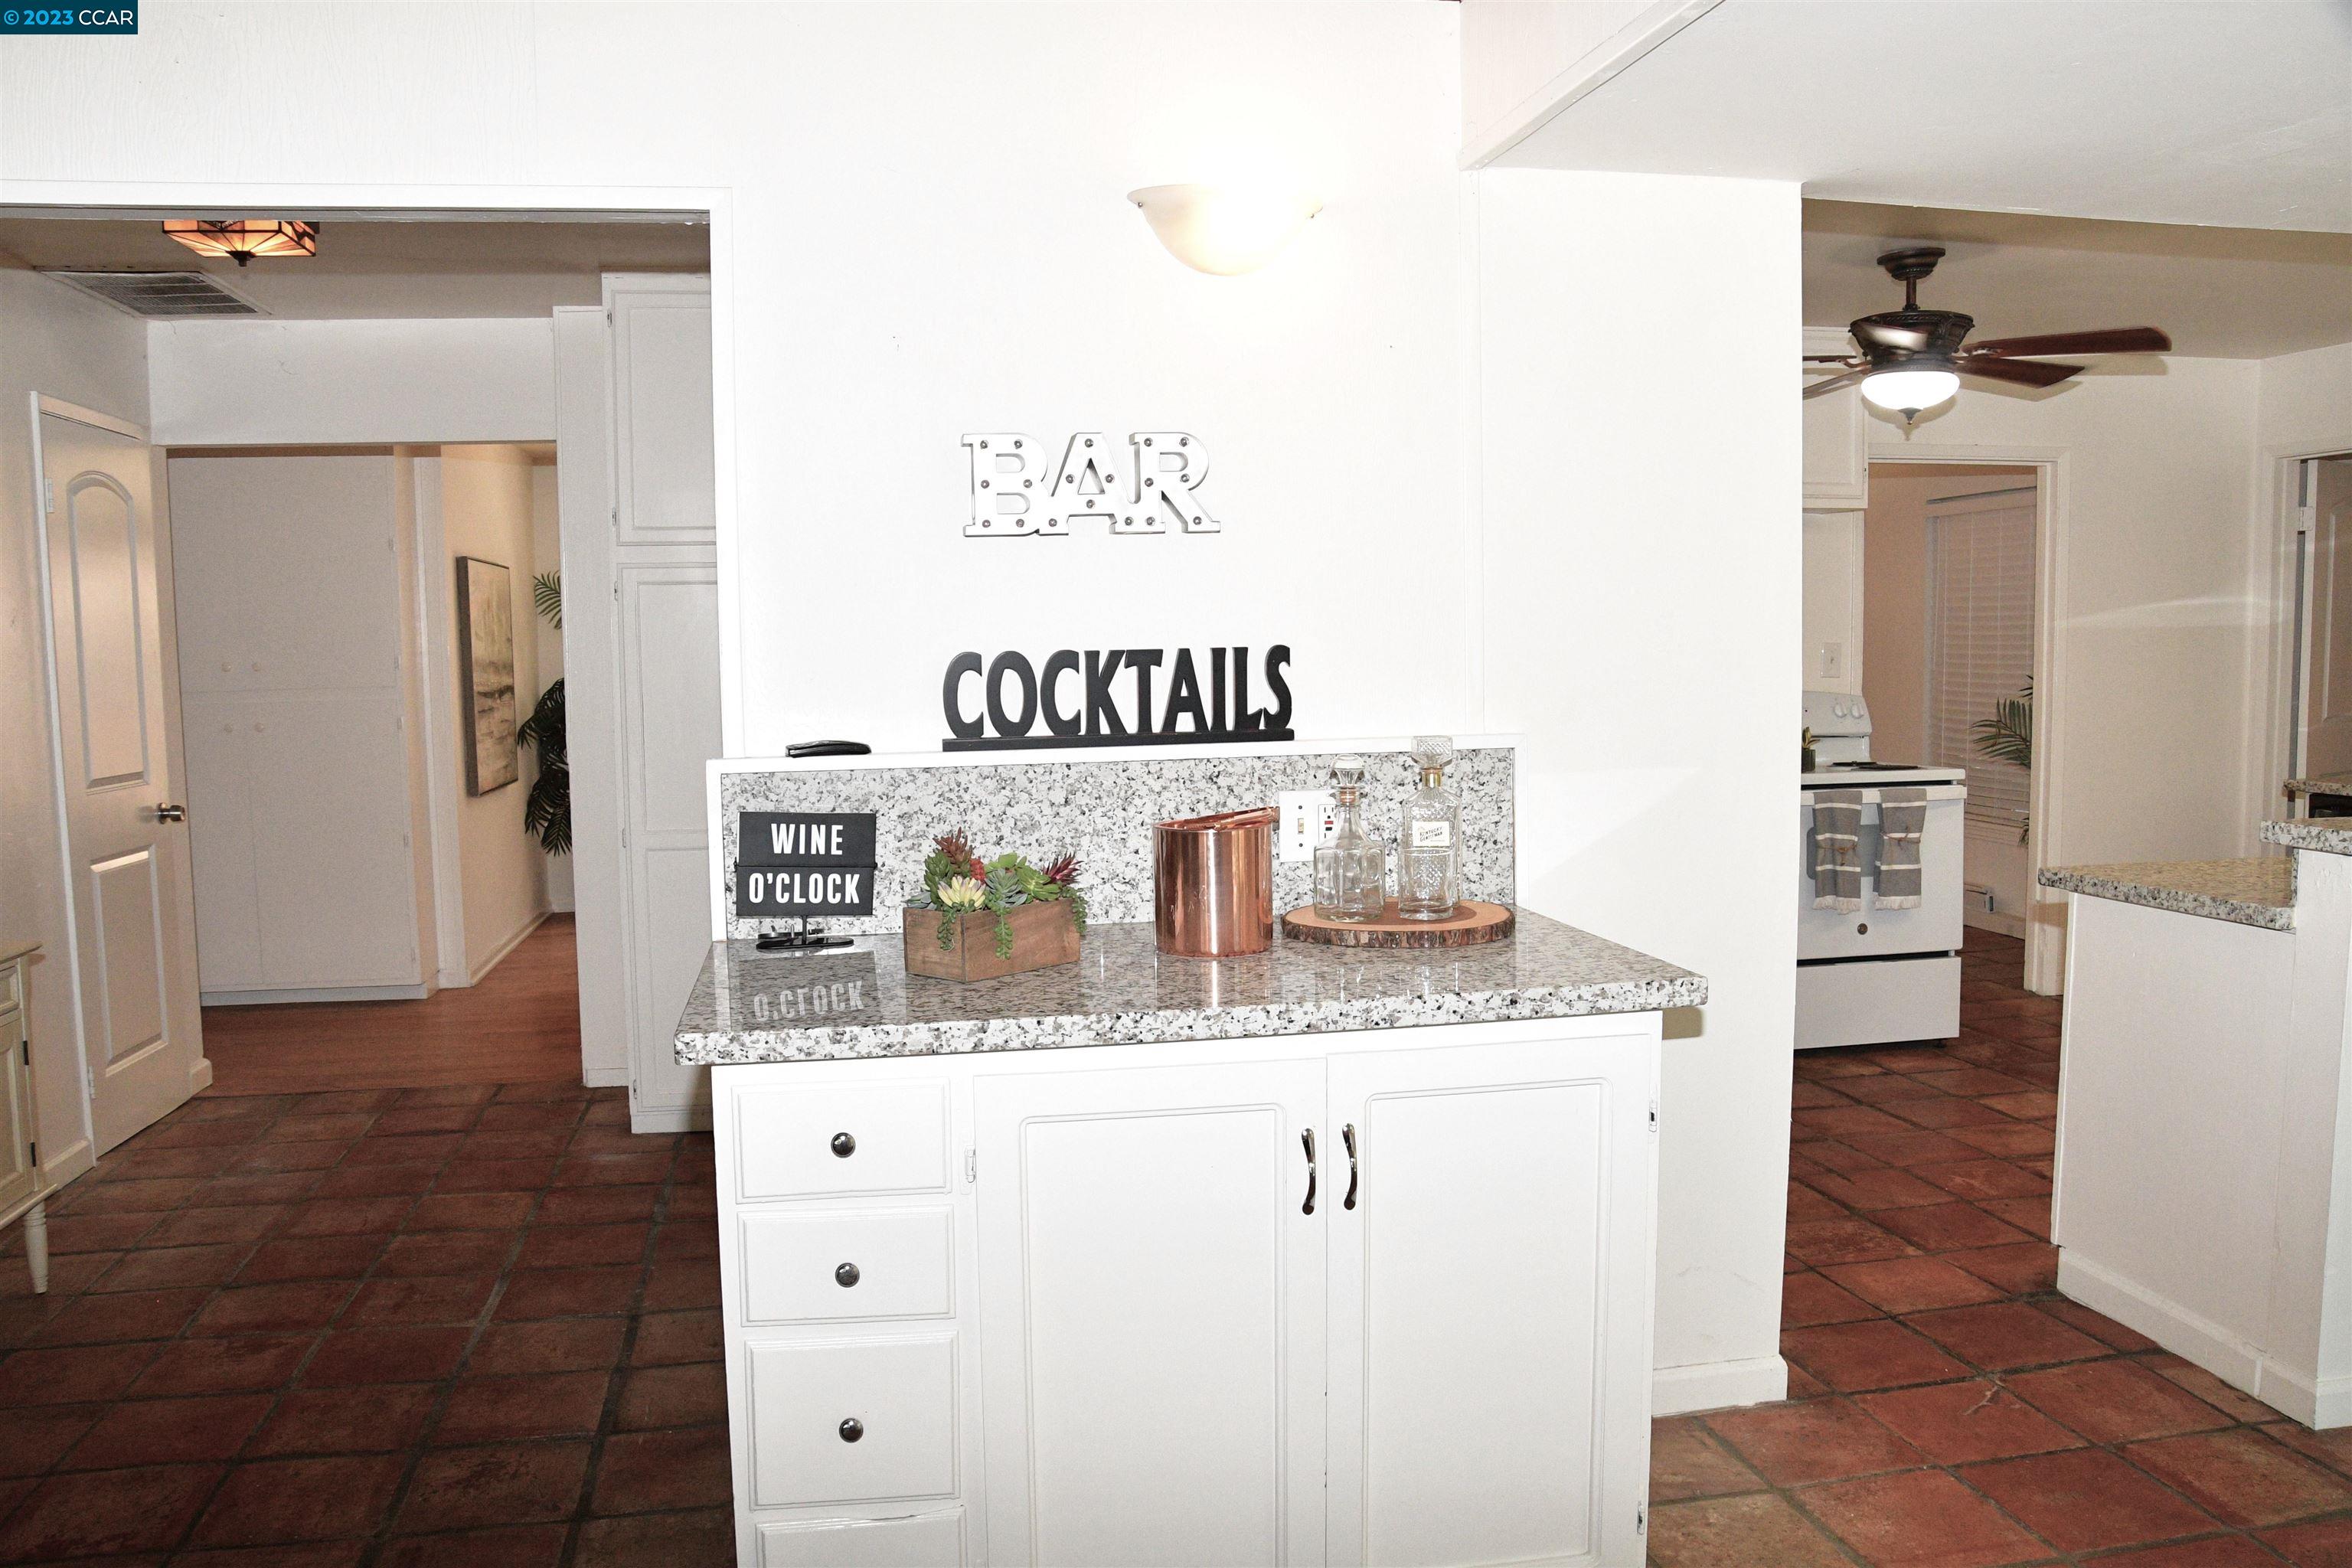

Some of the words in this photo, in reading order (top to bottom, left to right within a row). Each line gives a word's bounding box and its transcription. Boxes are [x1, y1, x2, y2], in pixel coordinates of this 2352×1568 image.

[961, 432, 1220, 537] BAR
[942, 645, 1292, 739] COCKTAILS
[771, 823, 844, 855] WINE
[749, 872, 860, 904] O'CLOCK
